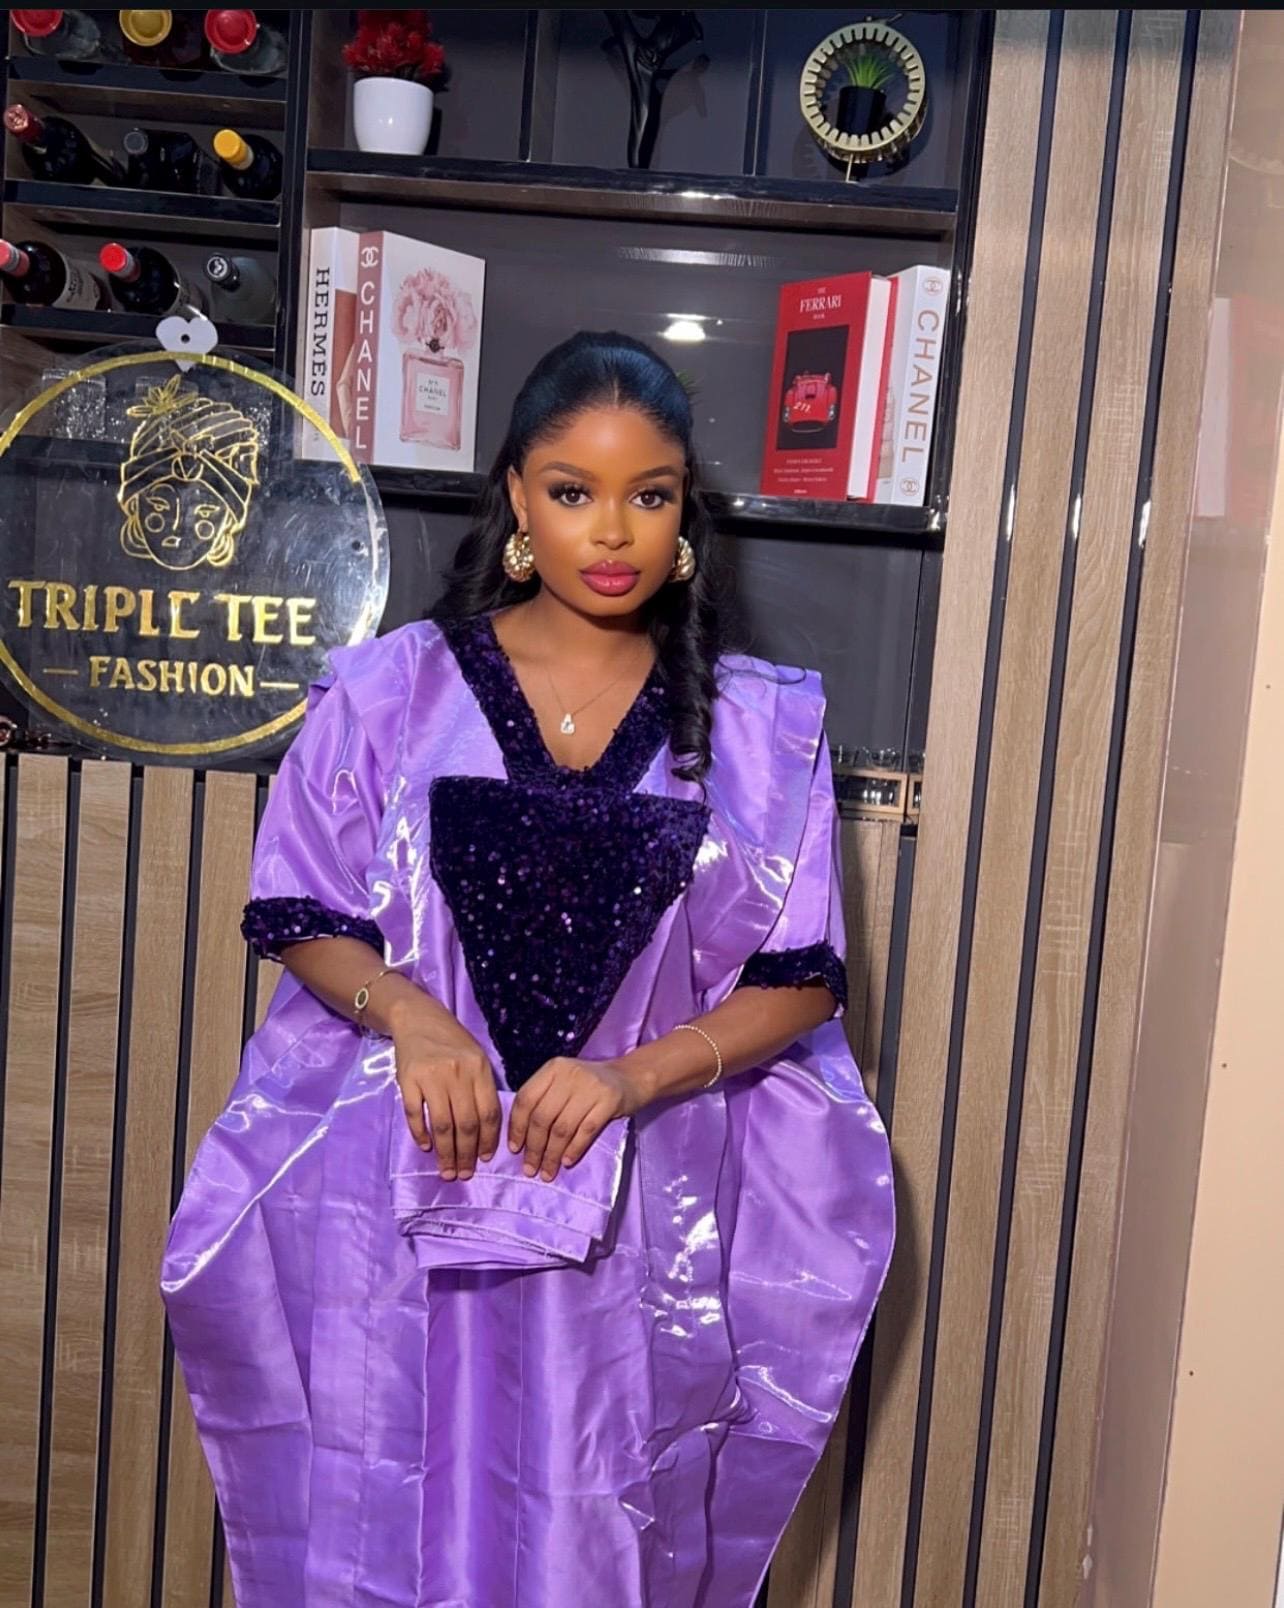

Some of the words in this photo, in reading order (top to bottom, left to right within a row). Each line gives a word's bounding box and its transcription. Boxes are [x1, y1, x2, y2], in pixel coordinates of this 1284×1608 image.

[800, 294, 842, 313] FERRARI
[355, 281, 375, 449] CHANEL
[901, 309, 940, 463] CHANEL
[214, 593, 316, 645] TEE
[89, 656, 255, 696] FASHION
